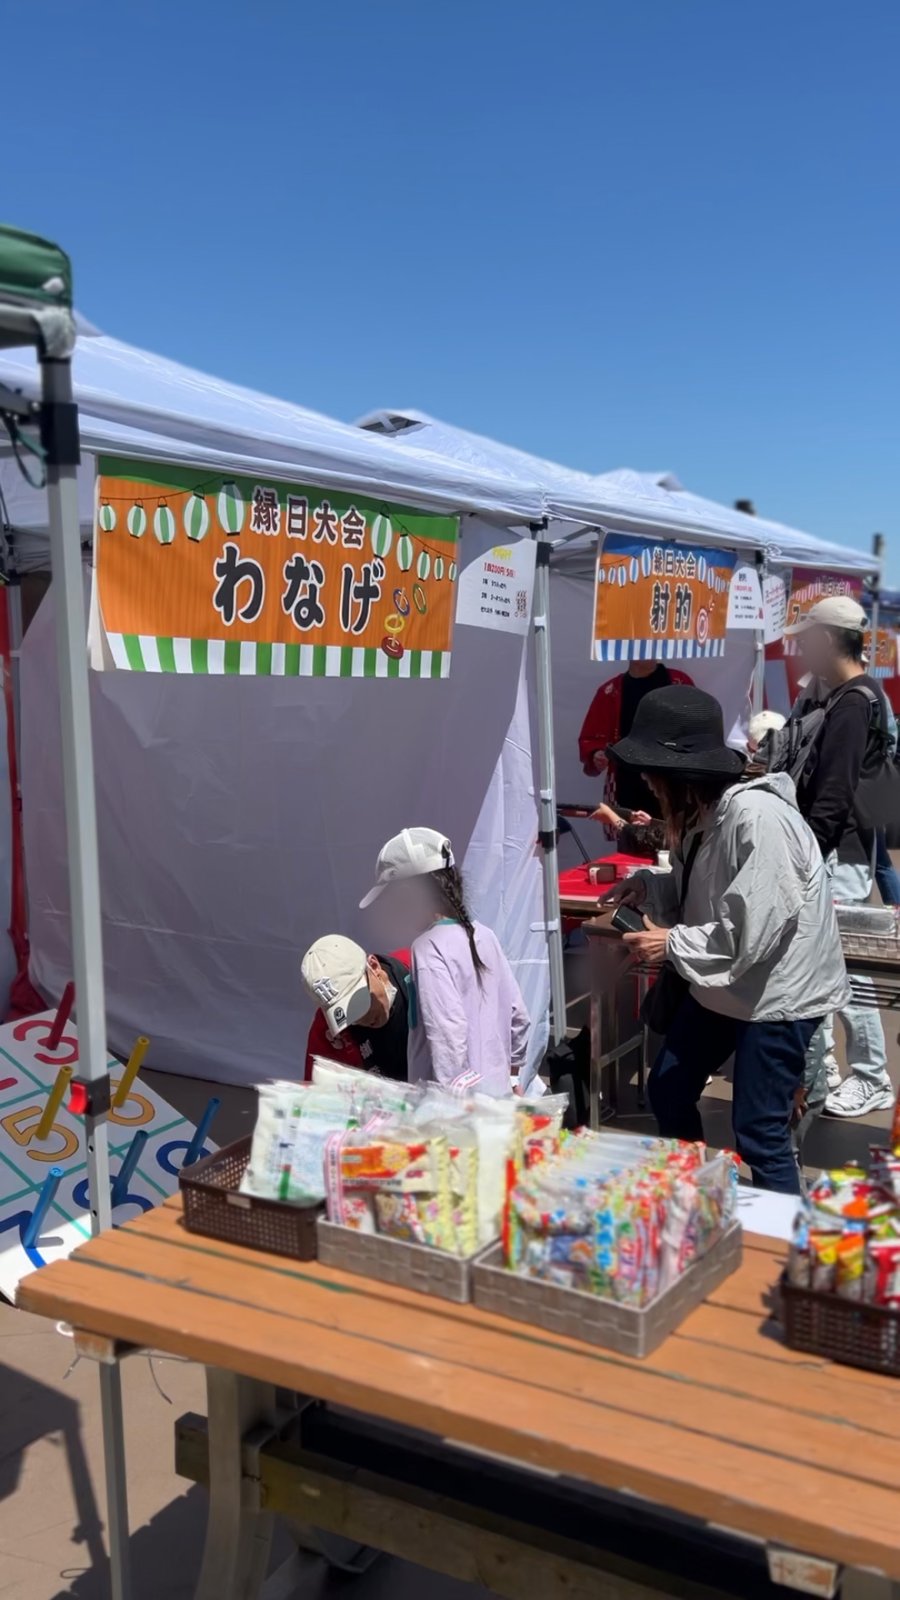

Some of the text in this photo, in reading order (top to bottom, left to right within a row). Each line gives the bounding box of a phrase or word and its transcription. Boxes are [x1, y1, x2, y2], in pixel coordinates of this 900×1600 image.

[250, 486, 366, 549] 縁日大会
[214, 541, 384, 636] わなげ
[650, 580, 693, 633] 射的
[1, 1106, 79, 1162] 5
